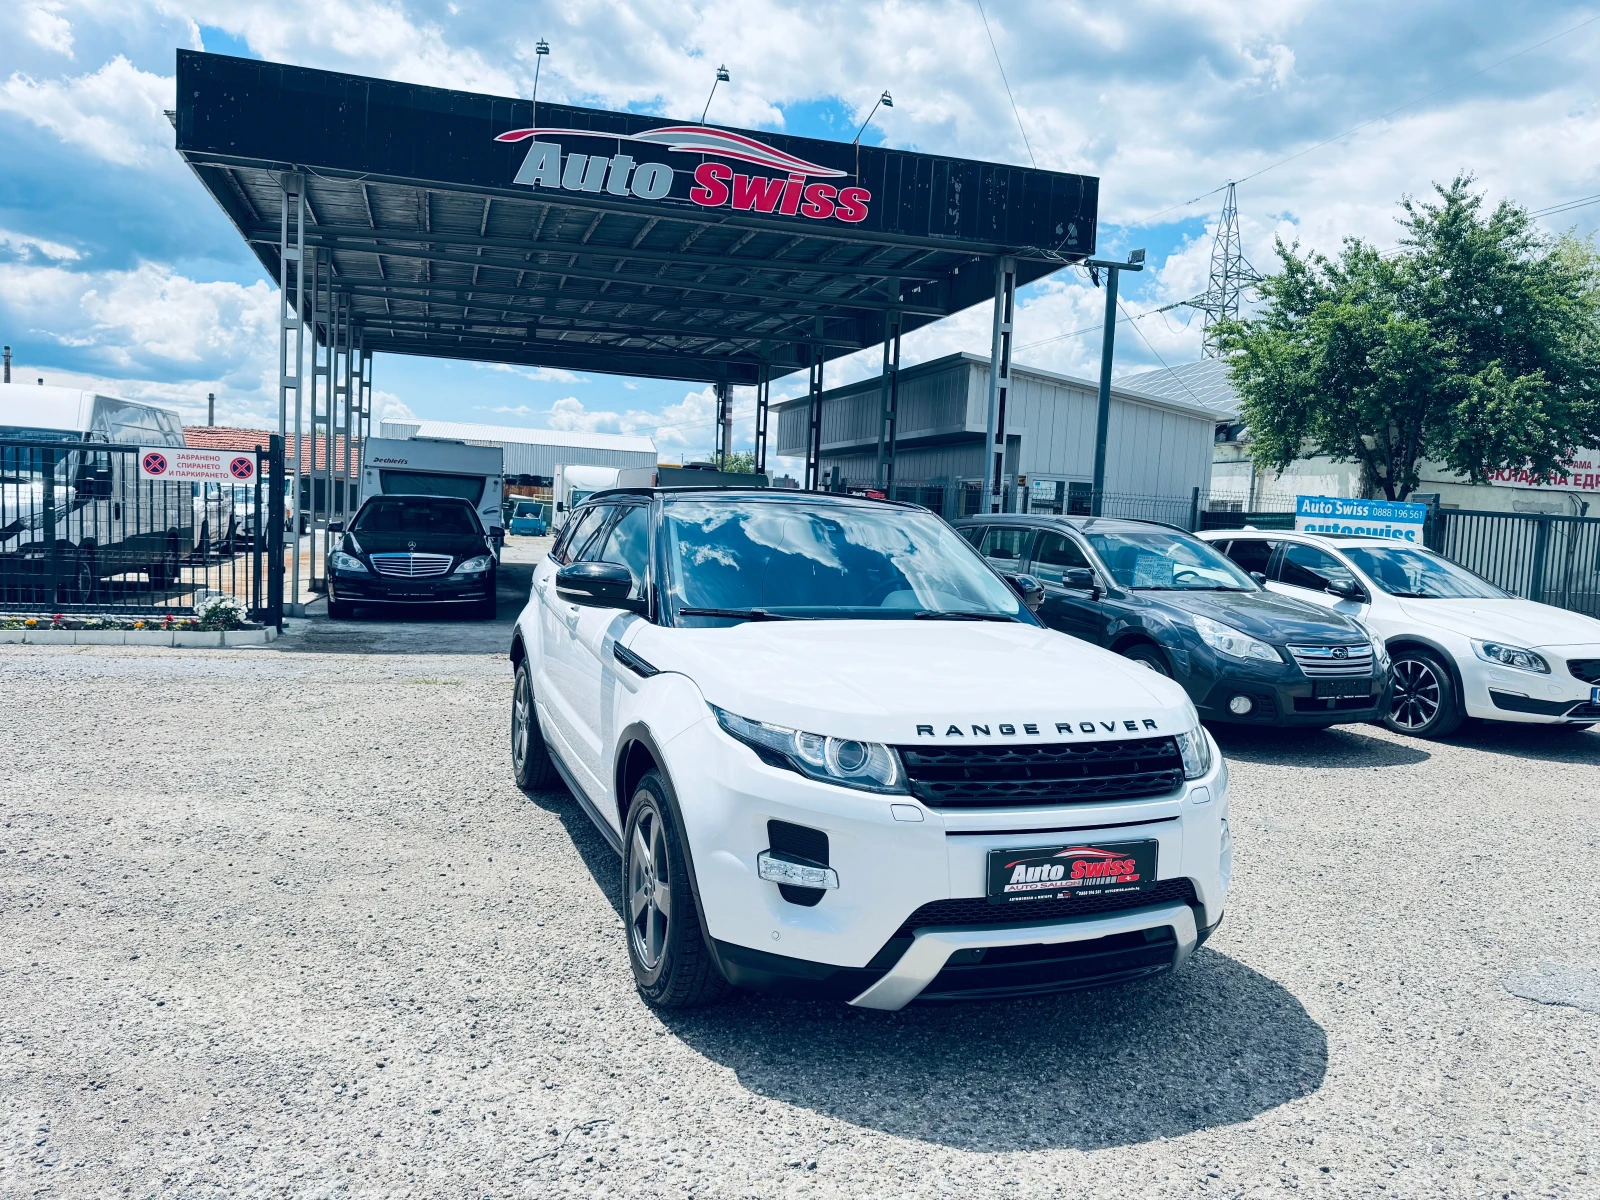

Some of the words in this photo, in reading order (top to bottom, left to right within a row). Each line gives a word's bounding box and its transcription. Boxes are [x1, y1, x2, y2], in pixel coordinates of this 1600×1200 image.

[513, 141, 674, 200] Auto
[689, 161, 871, 223] Swiss
[176, 453, 221, 462] ЗАБРАНЕНО
[176, 462, 221, 470] СПИРАНЕТО
[175, 471, 229, 479] ПАРКИРАНЕТО
[1301, 499, 1333, 514] Auto
[1335, 501, 1369, 516] Swiss
[1372, 507, 1392, 517] 0888
[1394, 509, 1408, 518] 196
[1409, 510, 1423, 519] 561
[916, 723, 1040, 737] RANGE
[1055, 718, 1158, 735] ROVER
[1010, 864, 1064, 883] Auto
[1071, 859, 1135, 878] Swiss
[1040, 880, 1080, 889] SALLON
